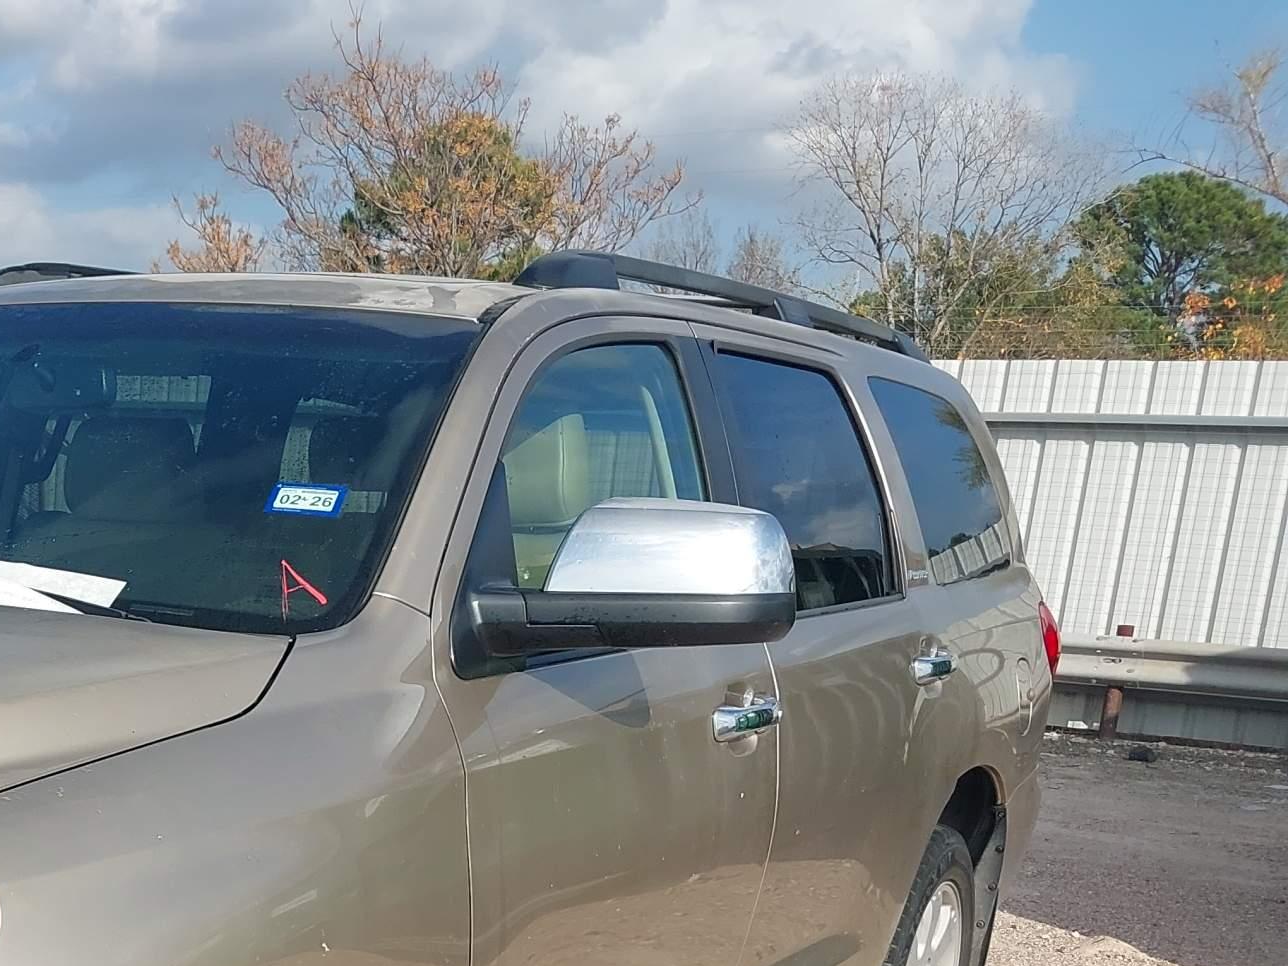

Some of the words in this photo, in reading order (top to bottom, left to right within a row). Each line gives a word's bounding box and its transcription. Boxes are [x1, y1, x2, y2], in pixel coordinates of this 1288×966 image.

[279, 494, 301, 505] 02
[309, 496, 333, 508] 26
[280, 559, 328, 622] A
